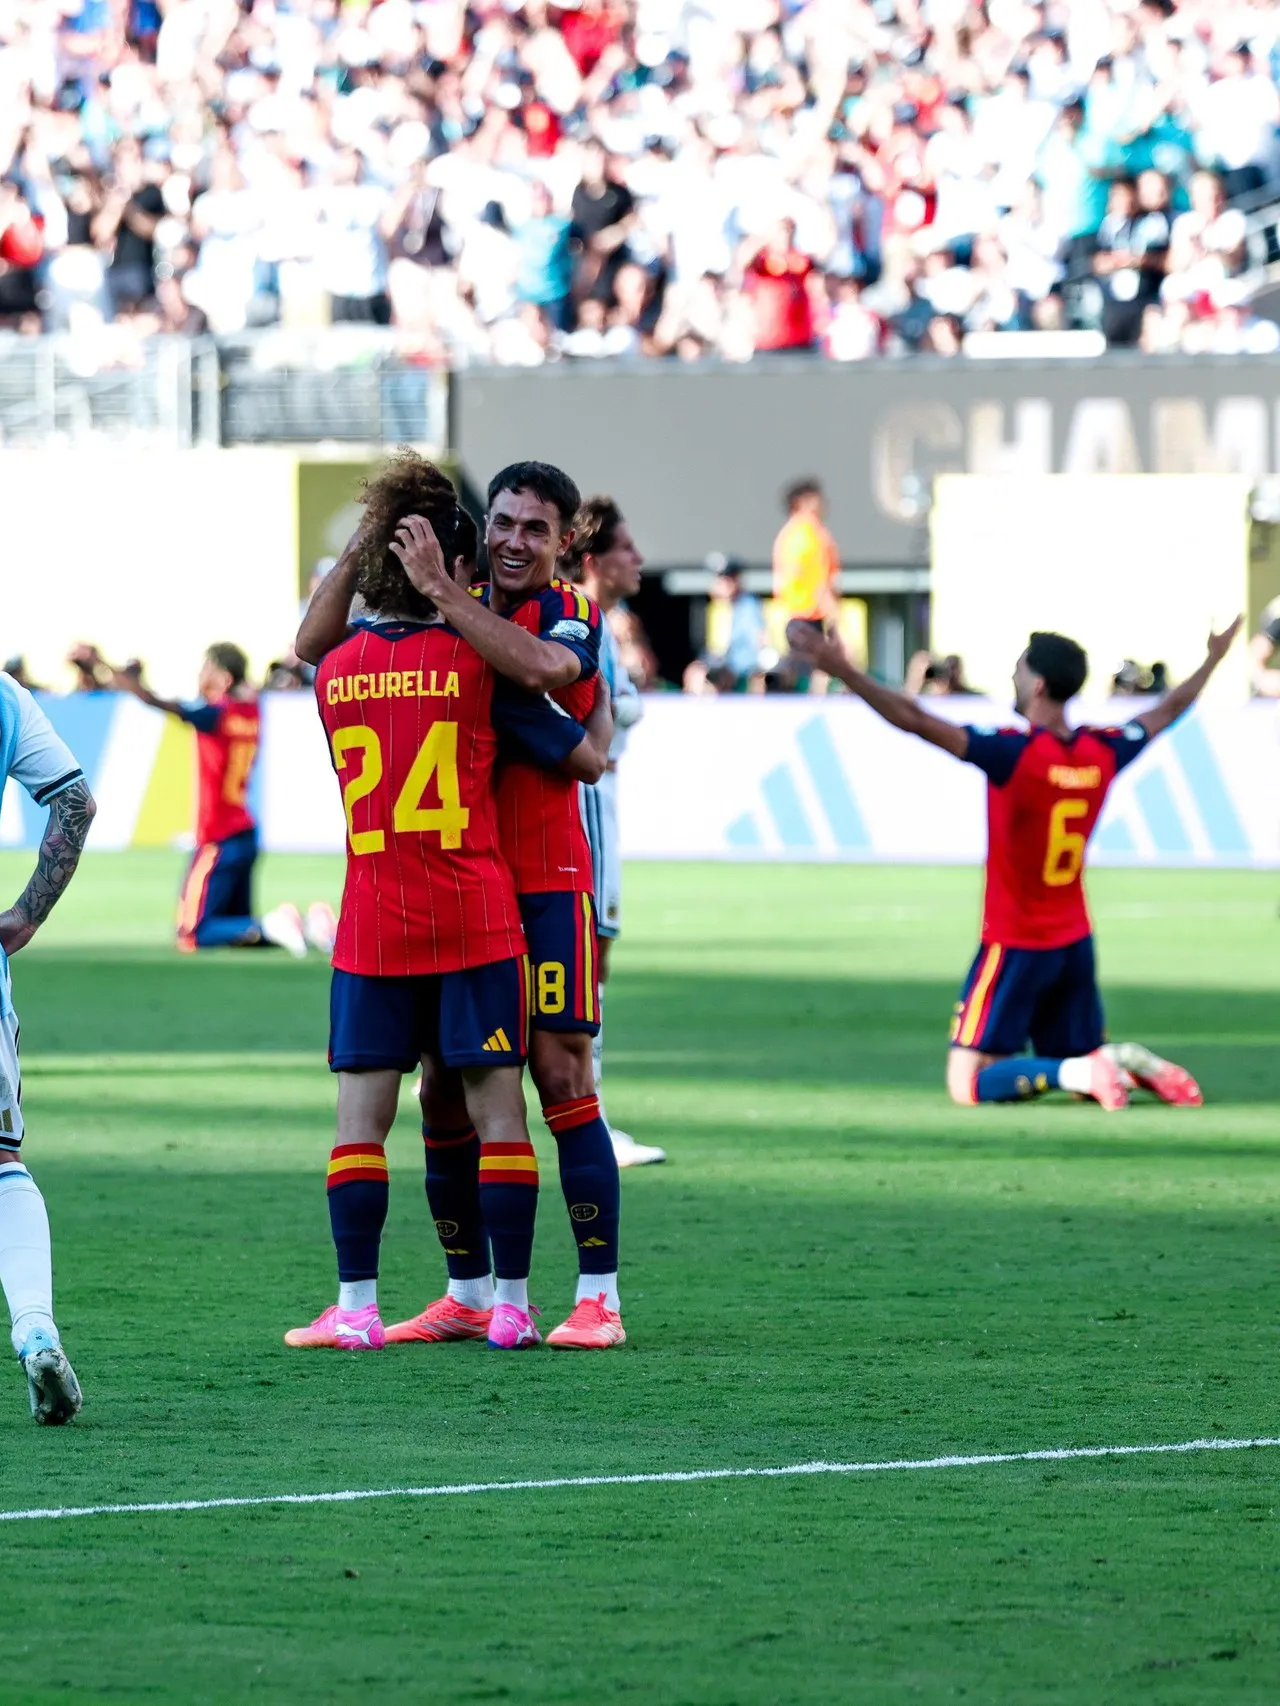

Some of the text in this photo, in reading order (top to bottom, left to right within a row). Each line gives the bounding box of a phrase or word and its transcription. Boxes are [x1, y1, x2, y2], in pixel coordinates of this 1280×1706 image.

[872, 396, 1280, 524] CHAM
[327, 671, 459, 705] CUCURELLA
[332, 721, 469, 855] 24
[1044, 798, 1089, 886] 6
